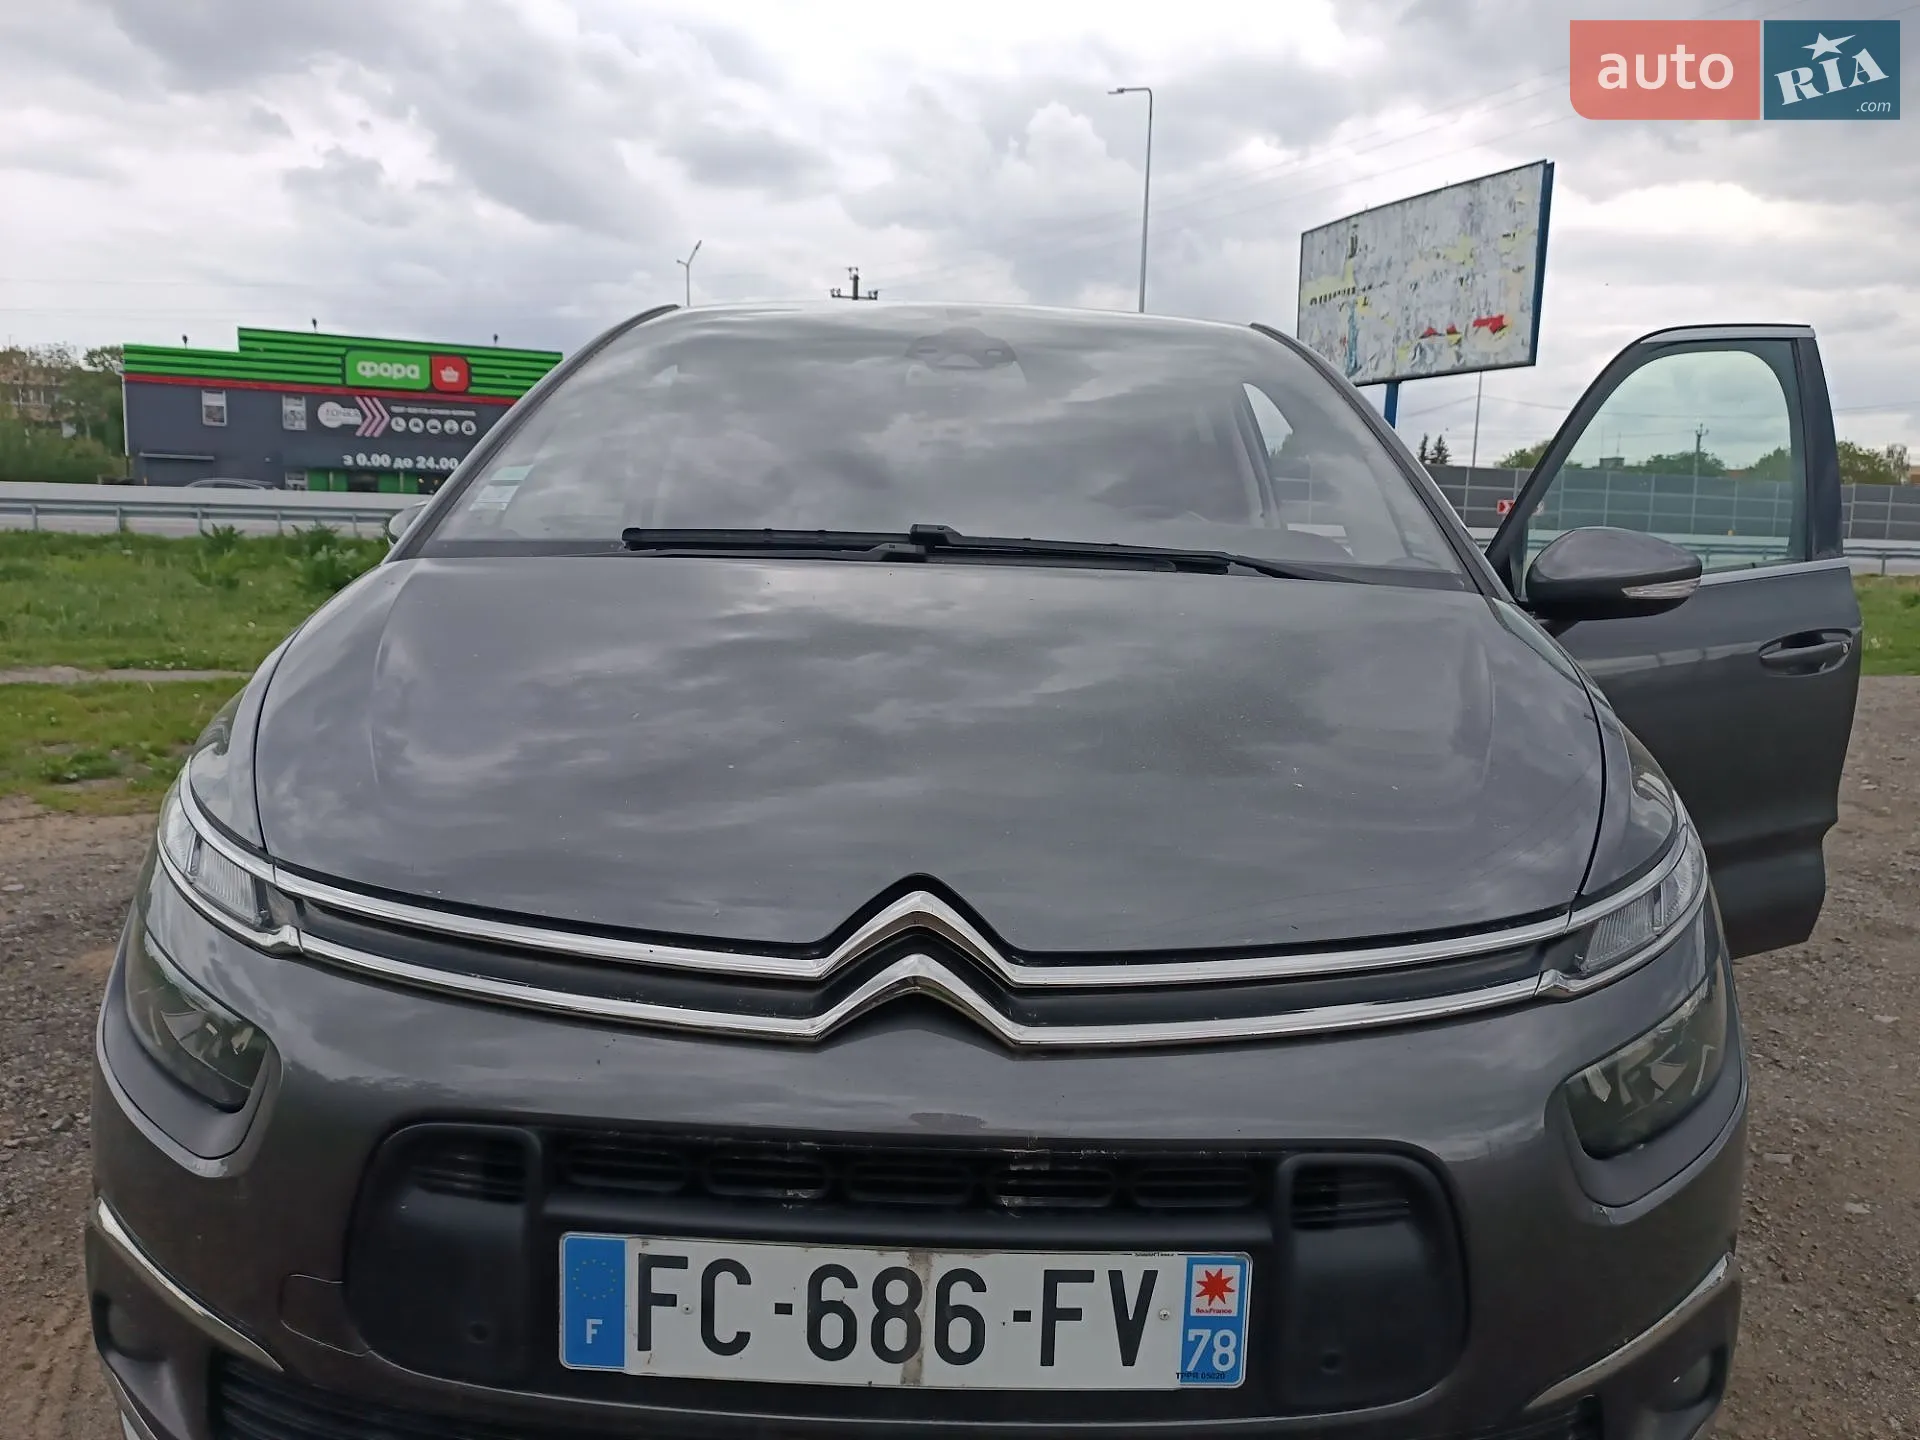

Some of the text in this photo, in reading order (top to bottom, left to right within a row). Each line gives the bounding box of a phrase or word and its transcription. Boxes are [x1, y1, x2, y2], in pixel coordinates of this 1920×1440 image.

[393, 457, 414, 470] до
[416, 455, 459, 471] 24.00
[637, 1252, 1159, 1367] FC-686-FV
[584, 1319, 603, 1345] F
[1186, 1328, 1237, 1373] 78
